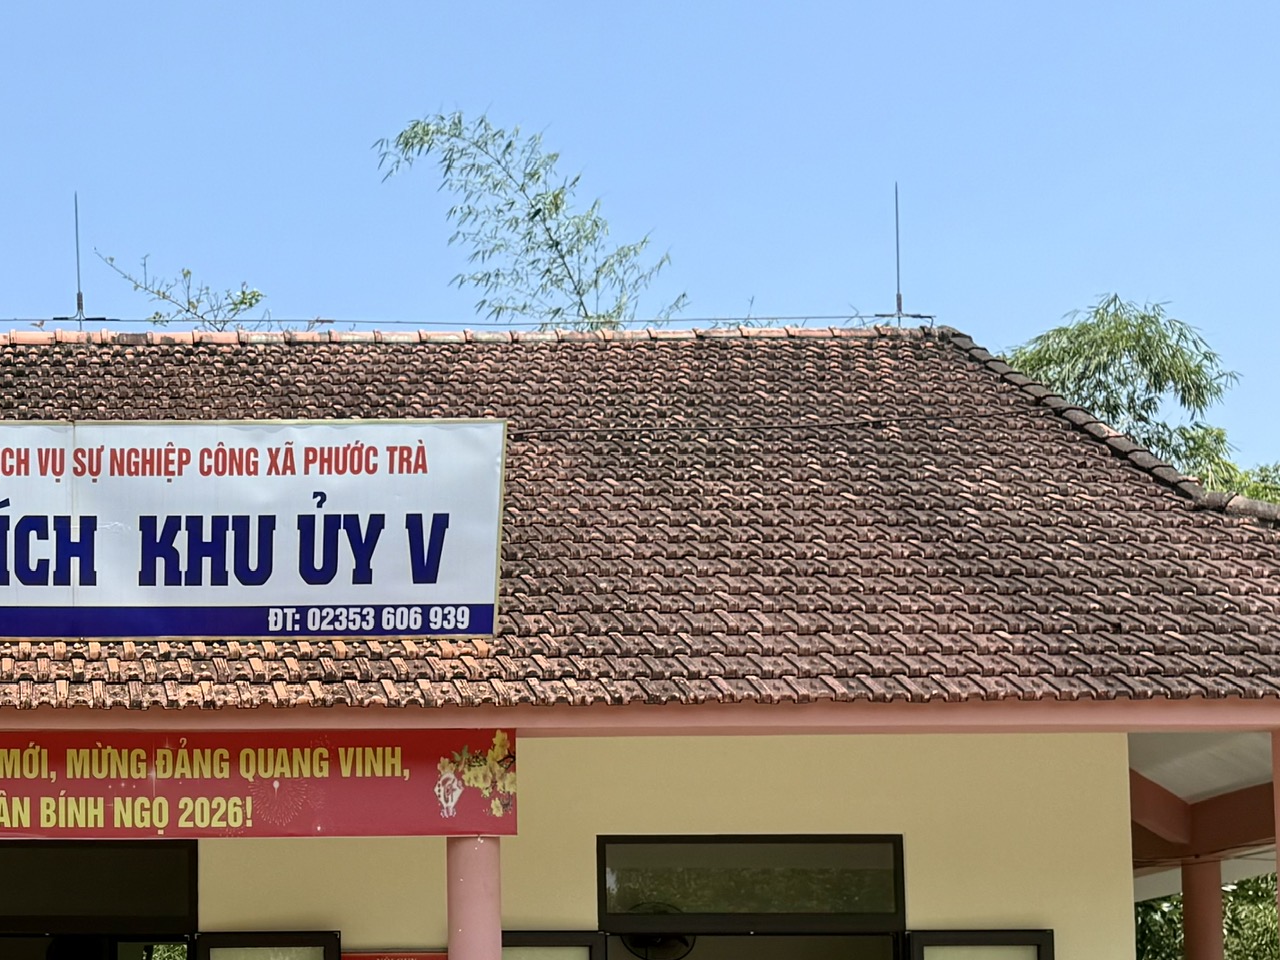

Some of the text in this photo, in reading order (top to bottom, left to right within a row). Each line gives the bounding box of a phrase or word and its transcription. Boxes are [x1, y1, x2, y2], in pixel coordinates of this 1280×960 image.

[37, 447, 65, 483] VỤ
[73, 445, 105, 483] SỰ
[110, 442, 191, 483] NGHIỆP
[199, 442, 259, 477] CÔNG
[266, 441, 296, 476] XÃ
[304, 440, 378, 475] PHƯỚC
[386, 439, 428, 475] TRÀ
[138, 514, 276, 586] KHU
[297, 491, 385, 586] ỦY
[405, 513, 449, 584] V
[268, 606, 470, 632] ĐT: 02353 606 939
[66, 741, 147, 779] MỪNG
[155, 737, 230, 779] ĐẢNG
[239, 747, 329, 782] QUANG
[338, 747, 410, 781] VINH,
[40, 790, 104, 828] BÍNH
[113, 796, 169, 835] NGỌ
[178, 796, 253, 828] 2026!
